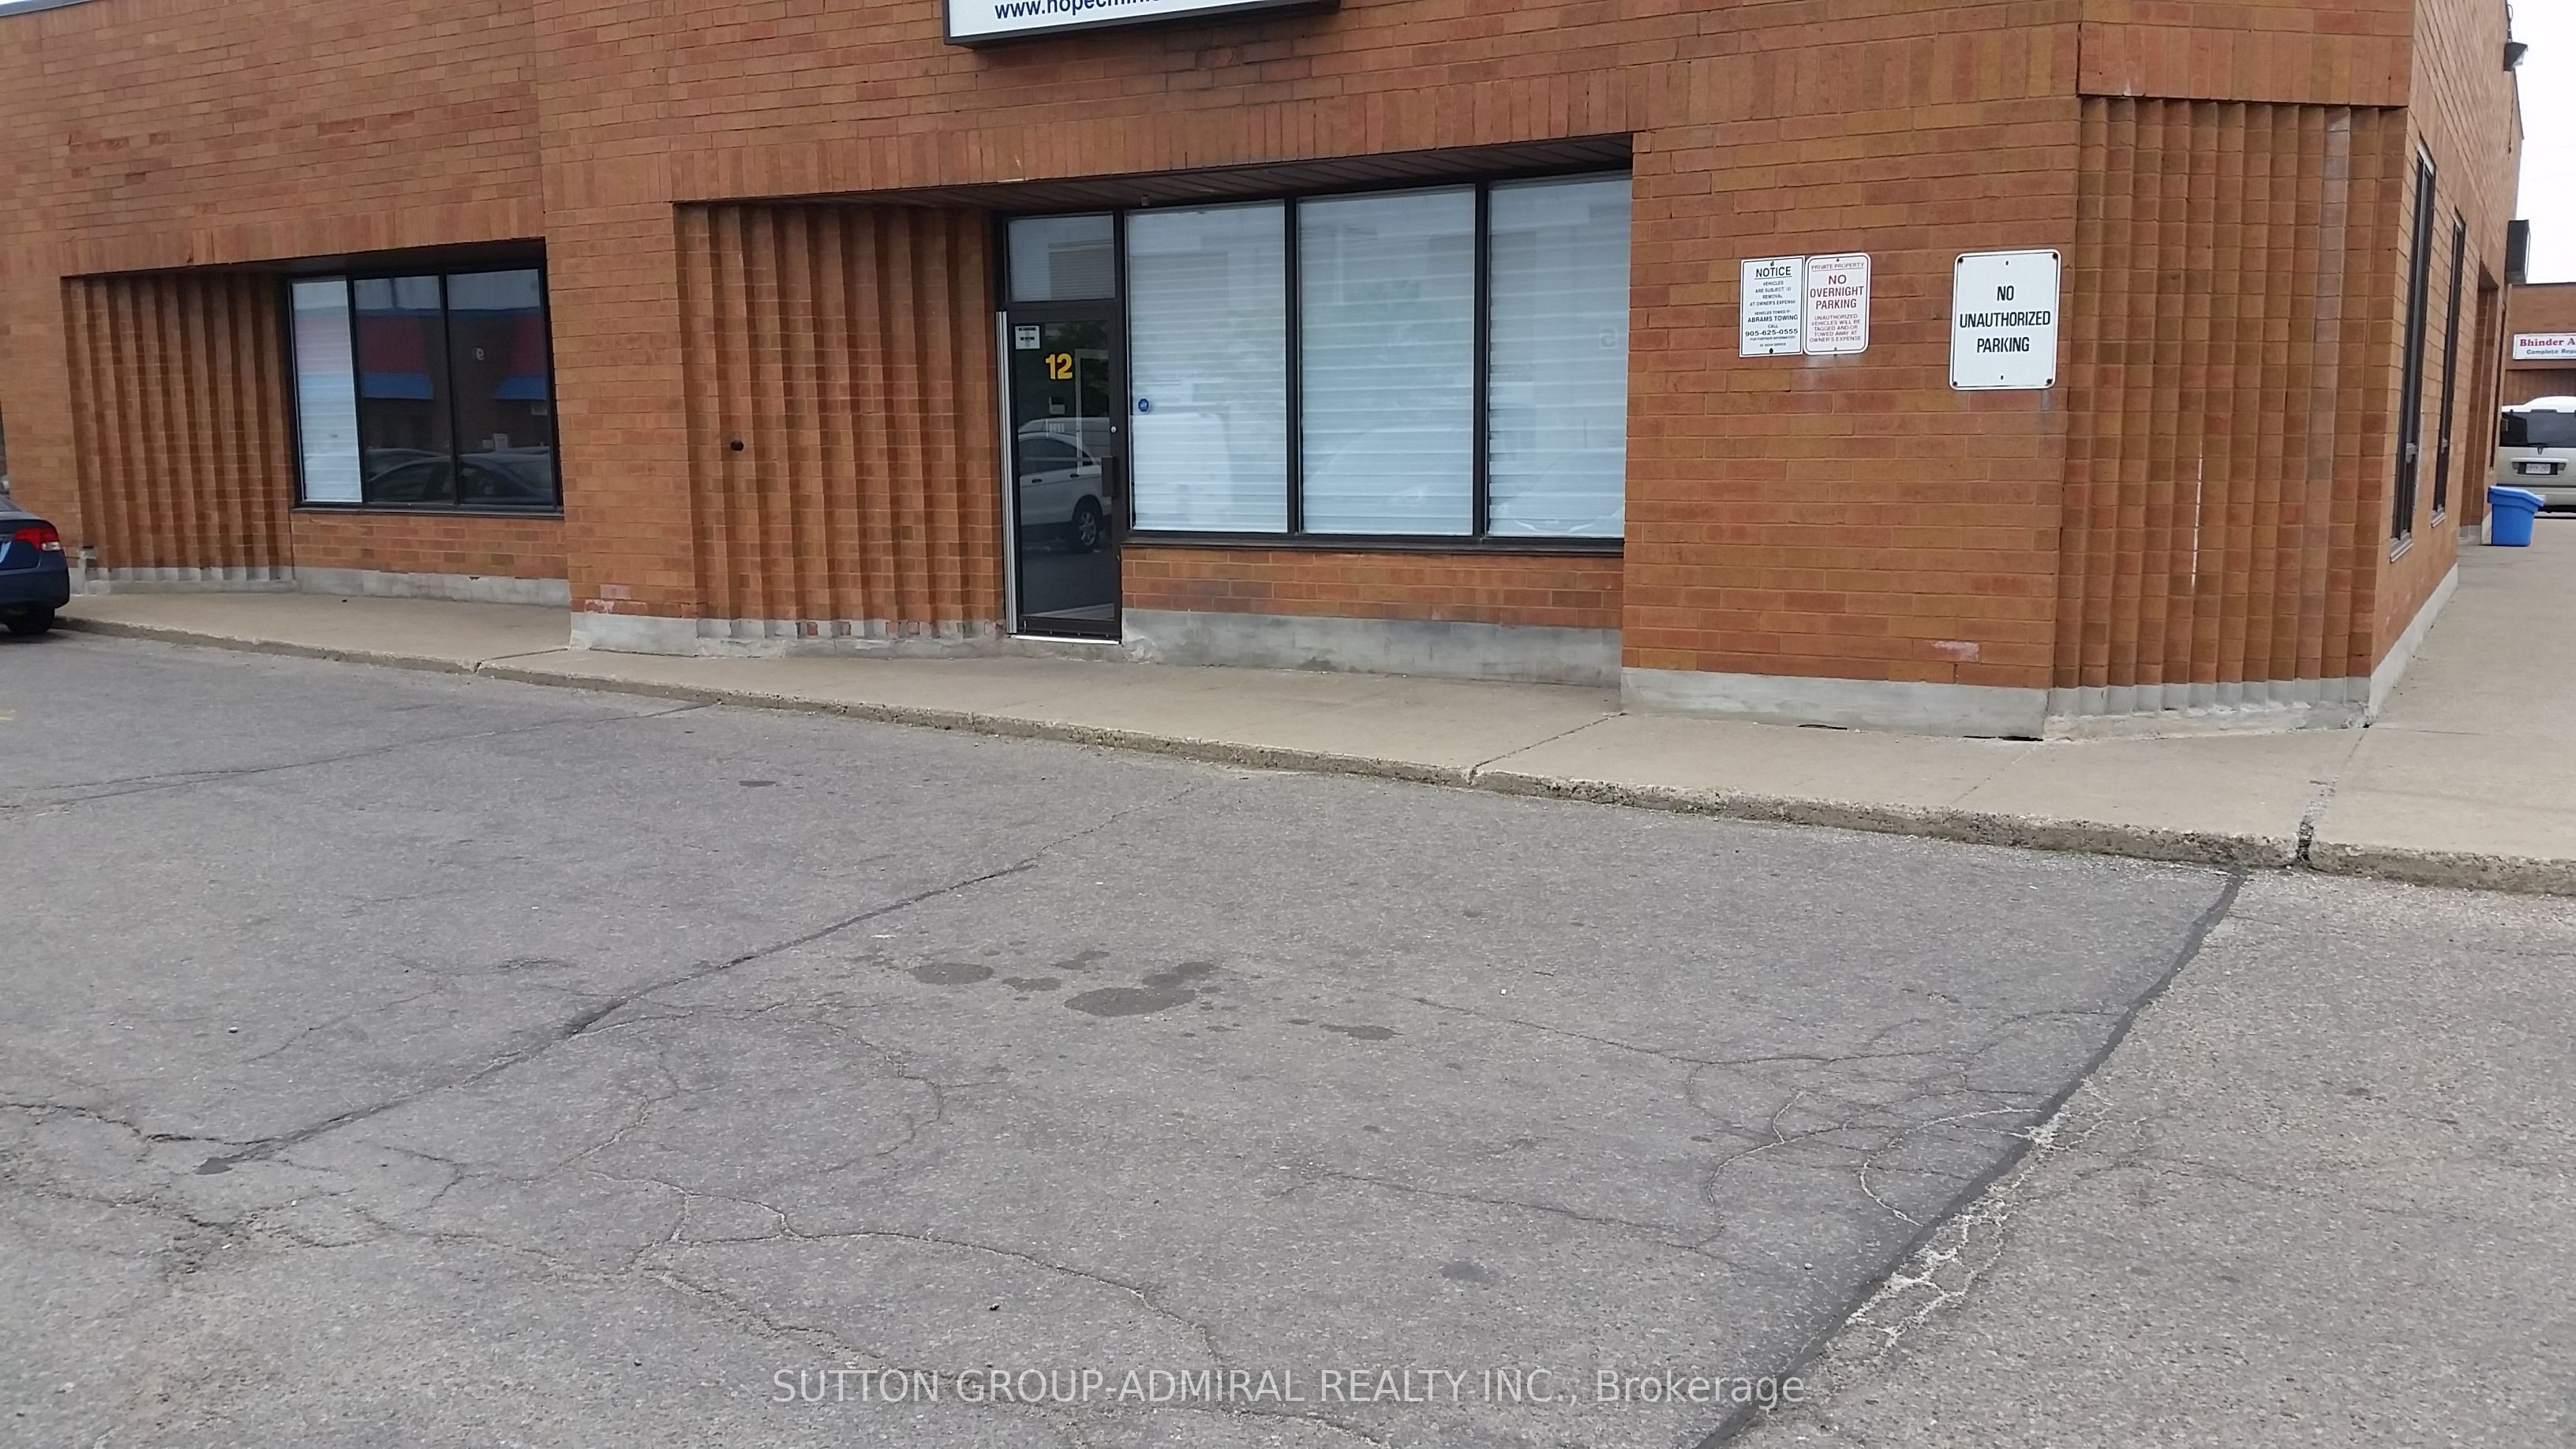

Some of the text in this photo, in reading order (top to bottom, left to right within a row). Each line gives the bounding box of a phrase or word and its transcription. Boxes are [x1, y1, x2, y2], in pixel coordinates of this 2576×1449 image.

[994, 0, 1159, 19] www.hopec
[1756, 266, 1791, 277] NOTICE
[1829, 274, 1846, 285] NO
[1810, 286, 1864, 298] OVERNIGHT
[1997, 286, 2014, 301] NO
[1816, 299, 1856, 310] PARKING
[1960, 311, 2051, 328] UNAUTHORIZED
[1745, 328, 1798, 337] 905-625-0555
[1977, 337, 2030, 353] PARKING
[2520, 338, 2564, 346] Bhinder
[1045, 353, 1073, 380] 12
